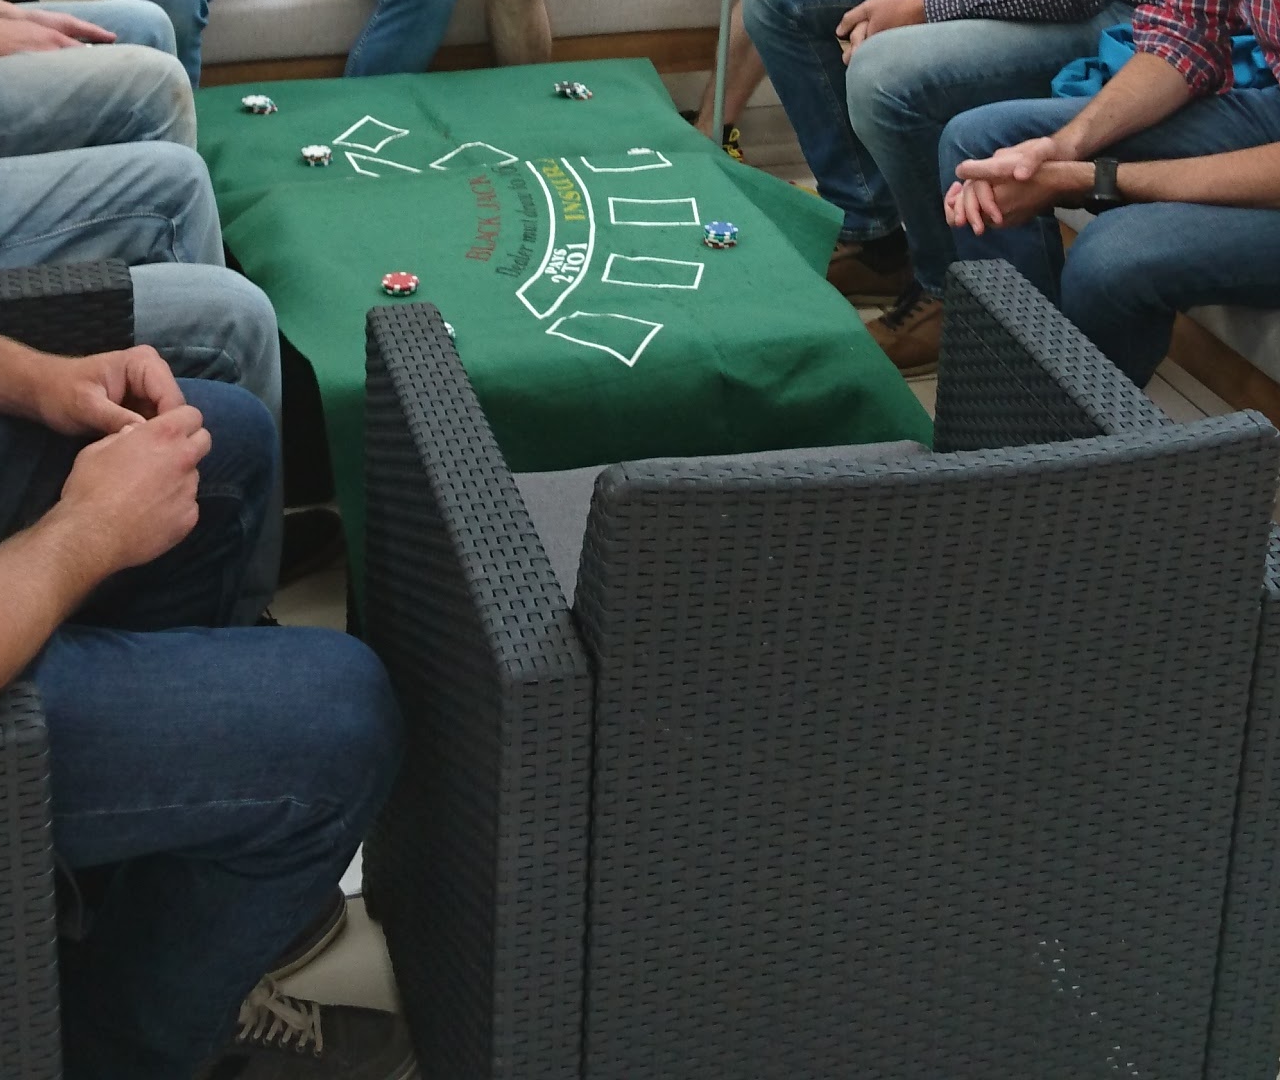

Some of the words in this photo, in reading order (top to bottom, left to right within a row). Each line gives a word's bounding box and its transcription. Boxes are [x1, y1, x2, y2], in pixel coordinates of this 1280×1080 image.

[470, 174, 501, 210] JACK
[465, 216, 501, 262] BLACK
[495, 244, 533, 278] Dealer
[545, 248, 567, 275] PAYS
[561, 252, 585, 273] TO
[551, 274, 575, 283] 2
